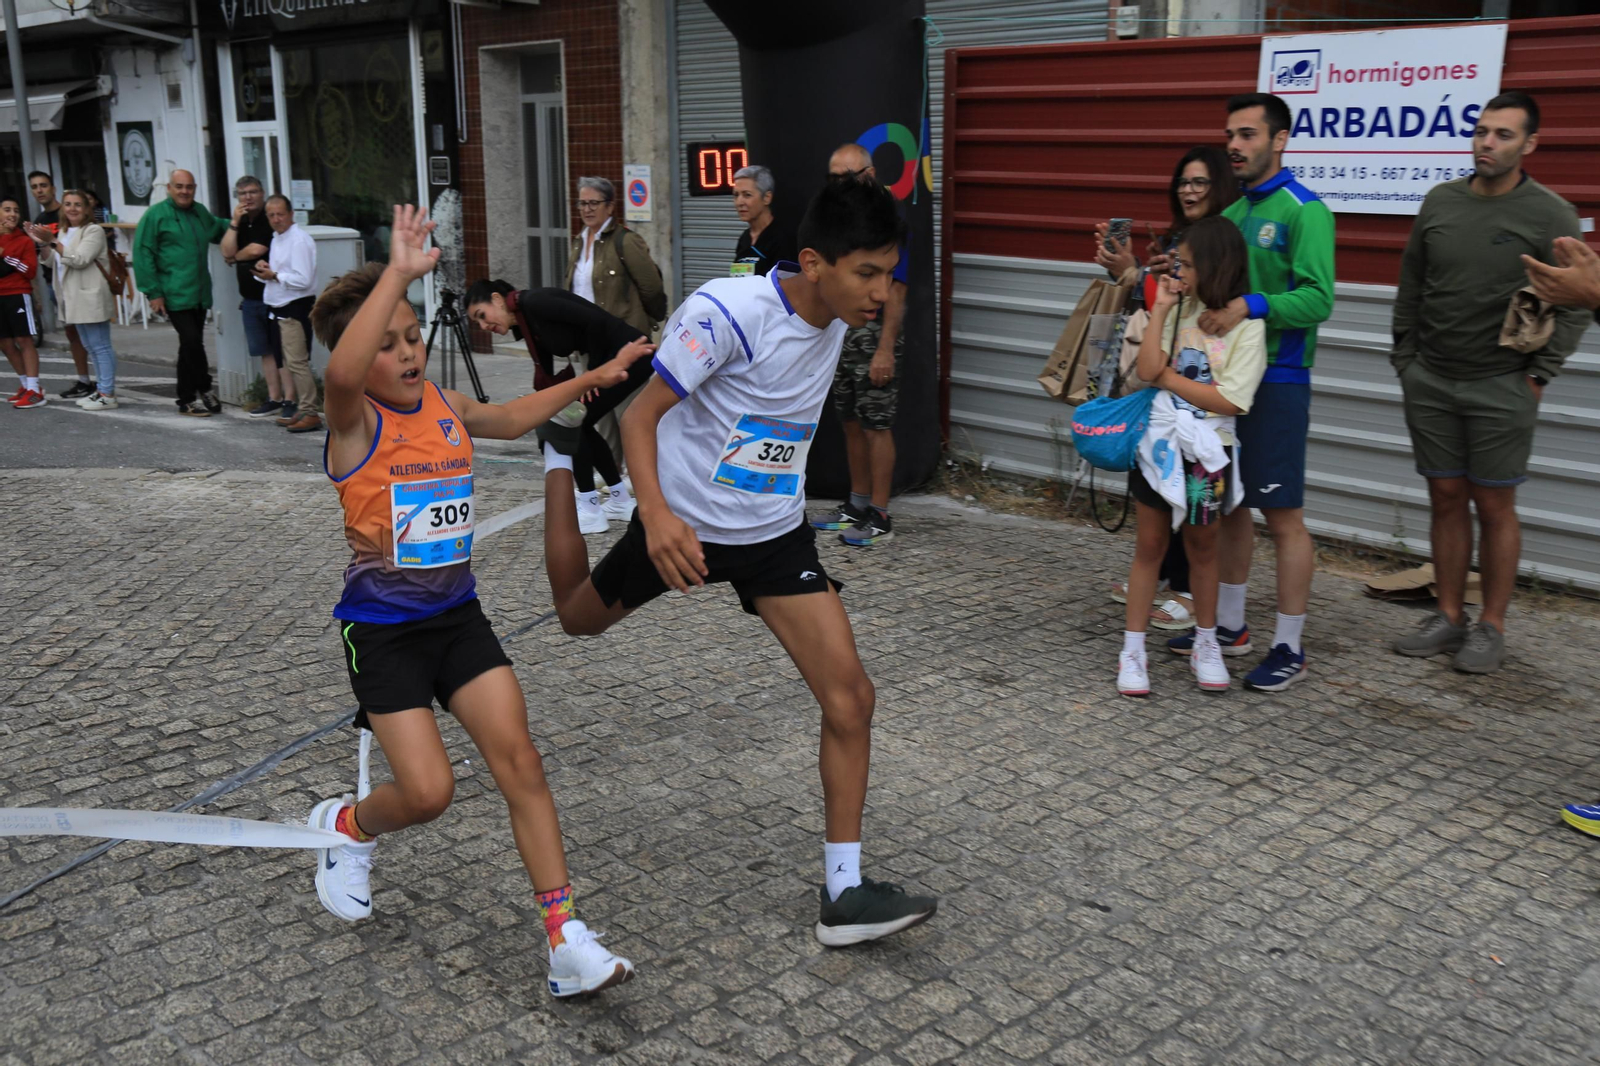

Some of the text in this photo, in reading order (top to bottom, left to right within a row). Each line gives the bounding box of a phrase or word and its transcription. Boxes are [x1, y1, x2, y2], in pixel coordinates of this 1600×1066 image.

[1328, 61, 1478, 87] hormigones
[1290, 94, 1481, 138] ARBADÁS
[1309, 166, 1326, 179] 38
[1329, 166, 1346, 179] 34
[1351, 166, 1367, 180] 15
[1380, 167, 1407, 180] 667
[1411, 167, 1430, 180] 24
[1434, 167, 1453, 181] 76
[1312, 189, 1427, 202] ormigonesbarbada
[673, 322, 716, 370] TENTH
[757, 442, 796, 463] 320
[389, 462, 434, 477] ATLETISMO
[402, 478, 469, 492] CARREIRA POPULAR
[430, 502, 470, 528] 309
